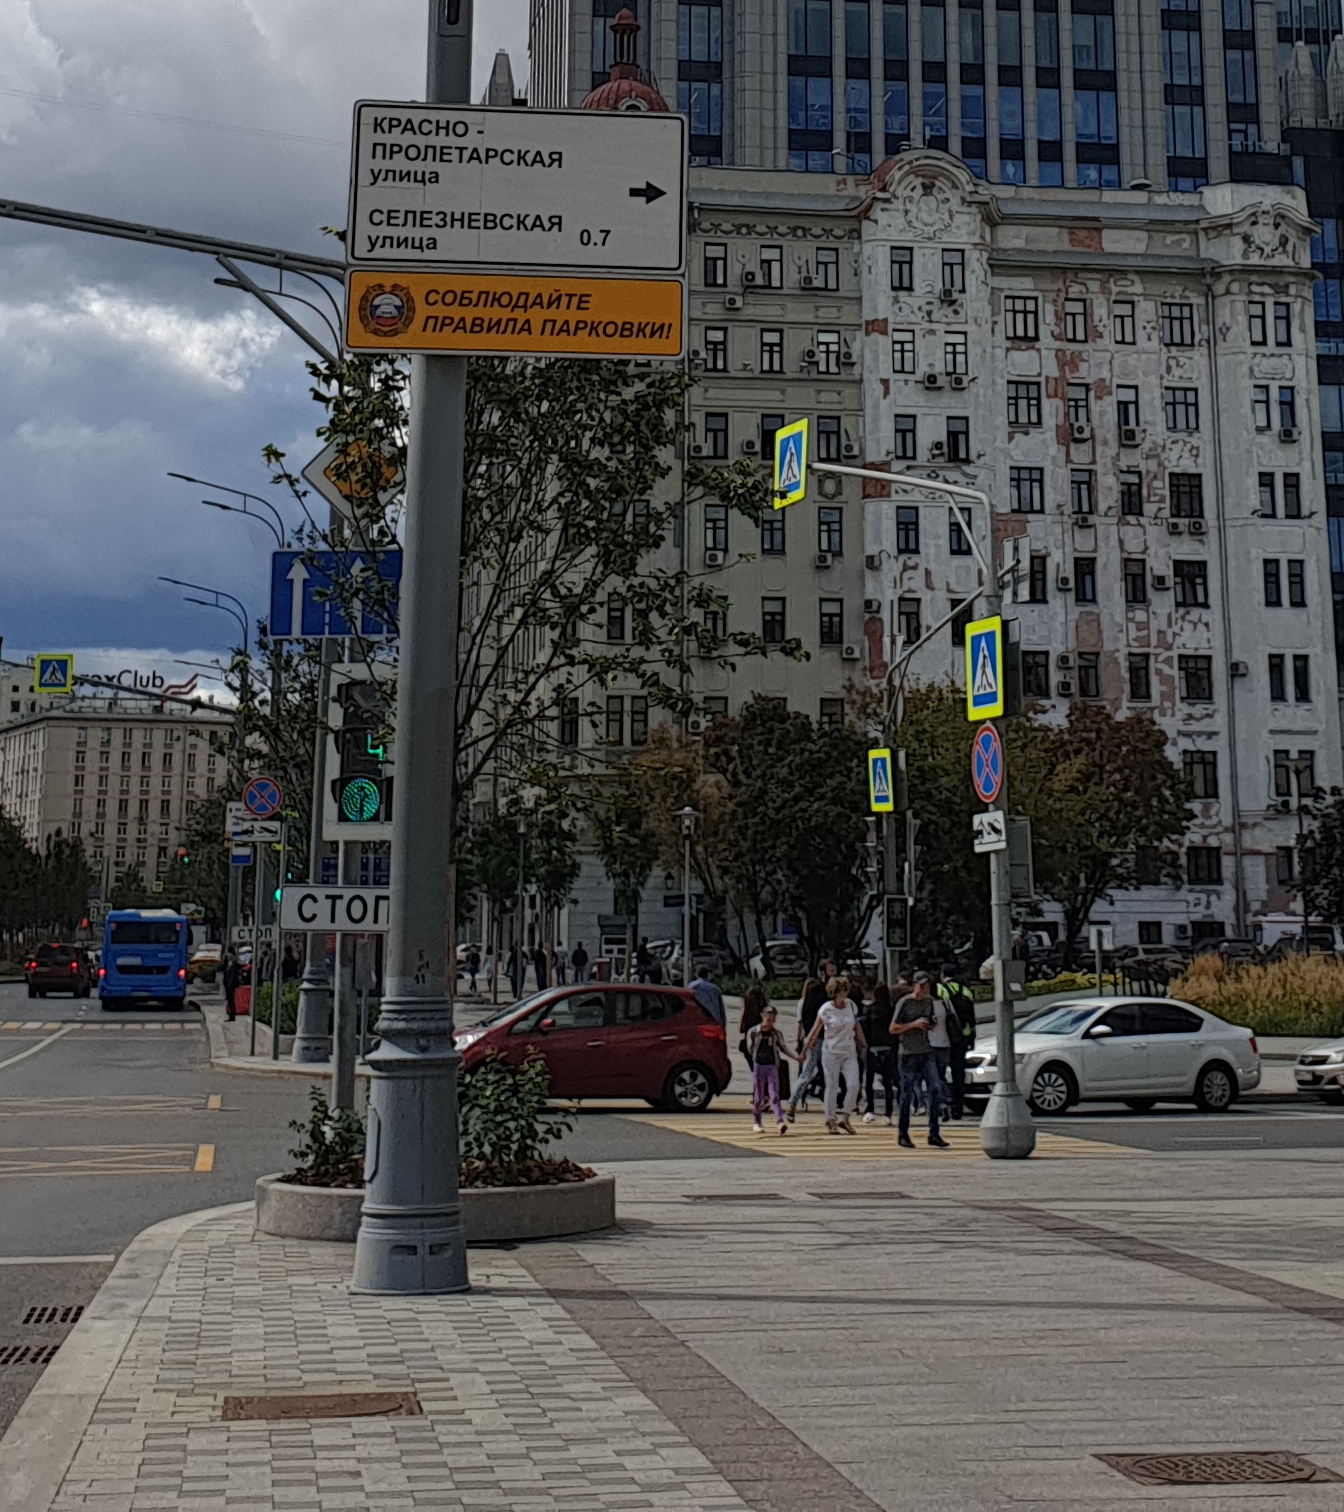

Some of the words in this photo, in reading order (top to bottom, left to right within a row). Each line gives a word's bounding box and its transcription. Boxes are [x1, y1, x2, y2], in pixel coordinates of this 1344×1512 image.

[372, 116, 469, 138] КРАСНО
[371, 142, 563, 169] ПРОЛЕТАРСКАЯ
[369, 168, 440, 186] улица
[368, 208, 563, 233] СЕЛЕЗНЕВСКАЯ
[366, 234, 438, 253] улица
[579, 228, 612, 247] 0.7
[423, 288, 592, 312] СОБЛЮДАЙТЕ
[421, 315, 533, 336] ПРАВИЛА
[540, 317, 673, 340] ПАРКОВКИ!
[297, 893, 390, 925] СТОП
